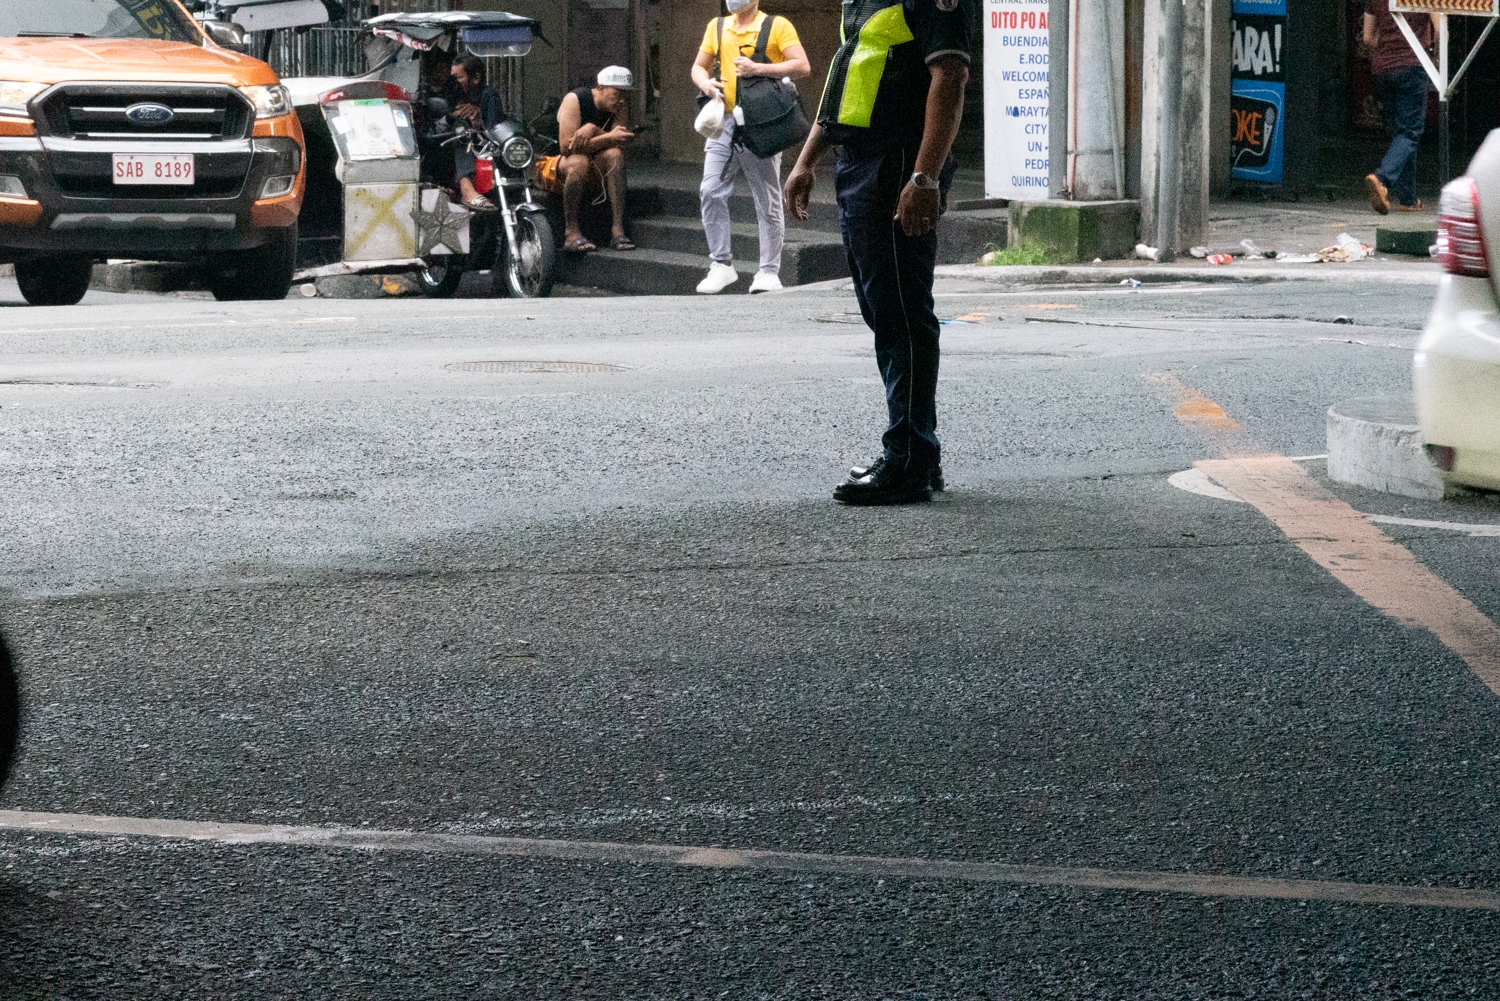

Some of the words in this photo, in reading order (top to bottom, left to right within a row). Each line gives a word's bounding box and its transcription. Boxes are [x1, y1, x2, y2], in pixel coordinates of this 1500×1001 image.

[991, 11, 1018, 29] DITO
[1020, 11, 1036, 29] PO
[1002, 35, 1049, 47] BUENDIA
[138, 107, 161, 120] Ford
[1024, 123, 1048, 135] CITY
[116, 161, 144, 178] SAB
[154, 161, 192, 179] 8189
[1011, 176, 1049, 188] QUIRINO
